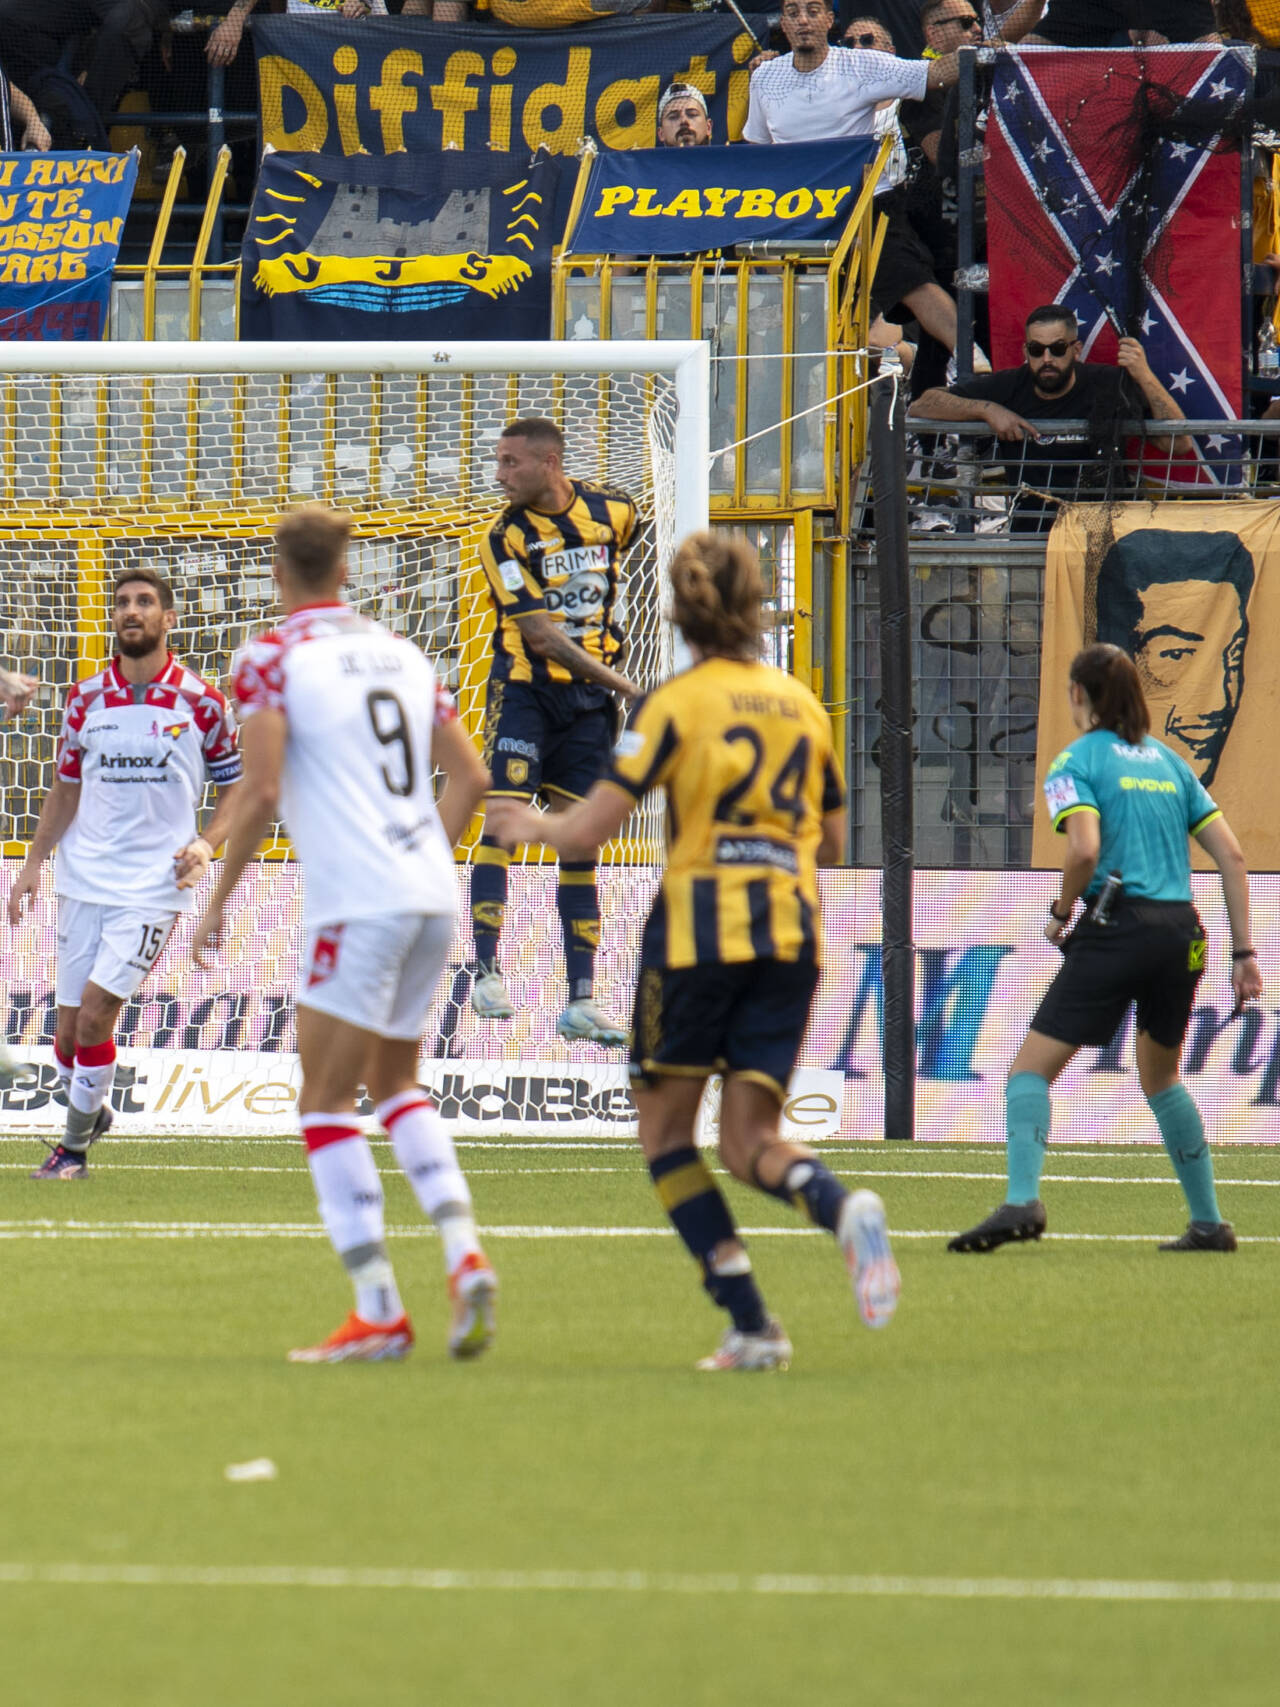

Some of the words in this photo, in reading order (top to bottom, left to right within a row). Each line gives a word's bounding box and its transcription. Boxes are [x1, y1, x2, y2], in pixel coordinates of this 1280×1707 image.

[23, 156, 130, 186] ANNI
[26, 187, 93, 220] TE,
[595, 184, 851, 220] PLAYBOY
[101, 752, 153, 769] Arinox
[366, 689, 415, 797] 9
[714, 722, 810, 835] 24
[1120, 776, 1177, 793] GIVOVA
[137, 923, 163, 961] 15
[152, 1063, 298, 1115] live
